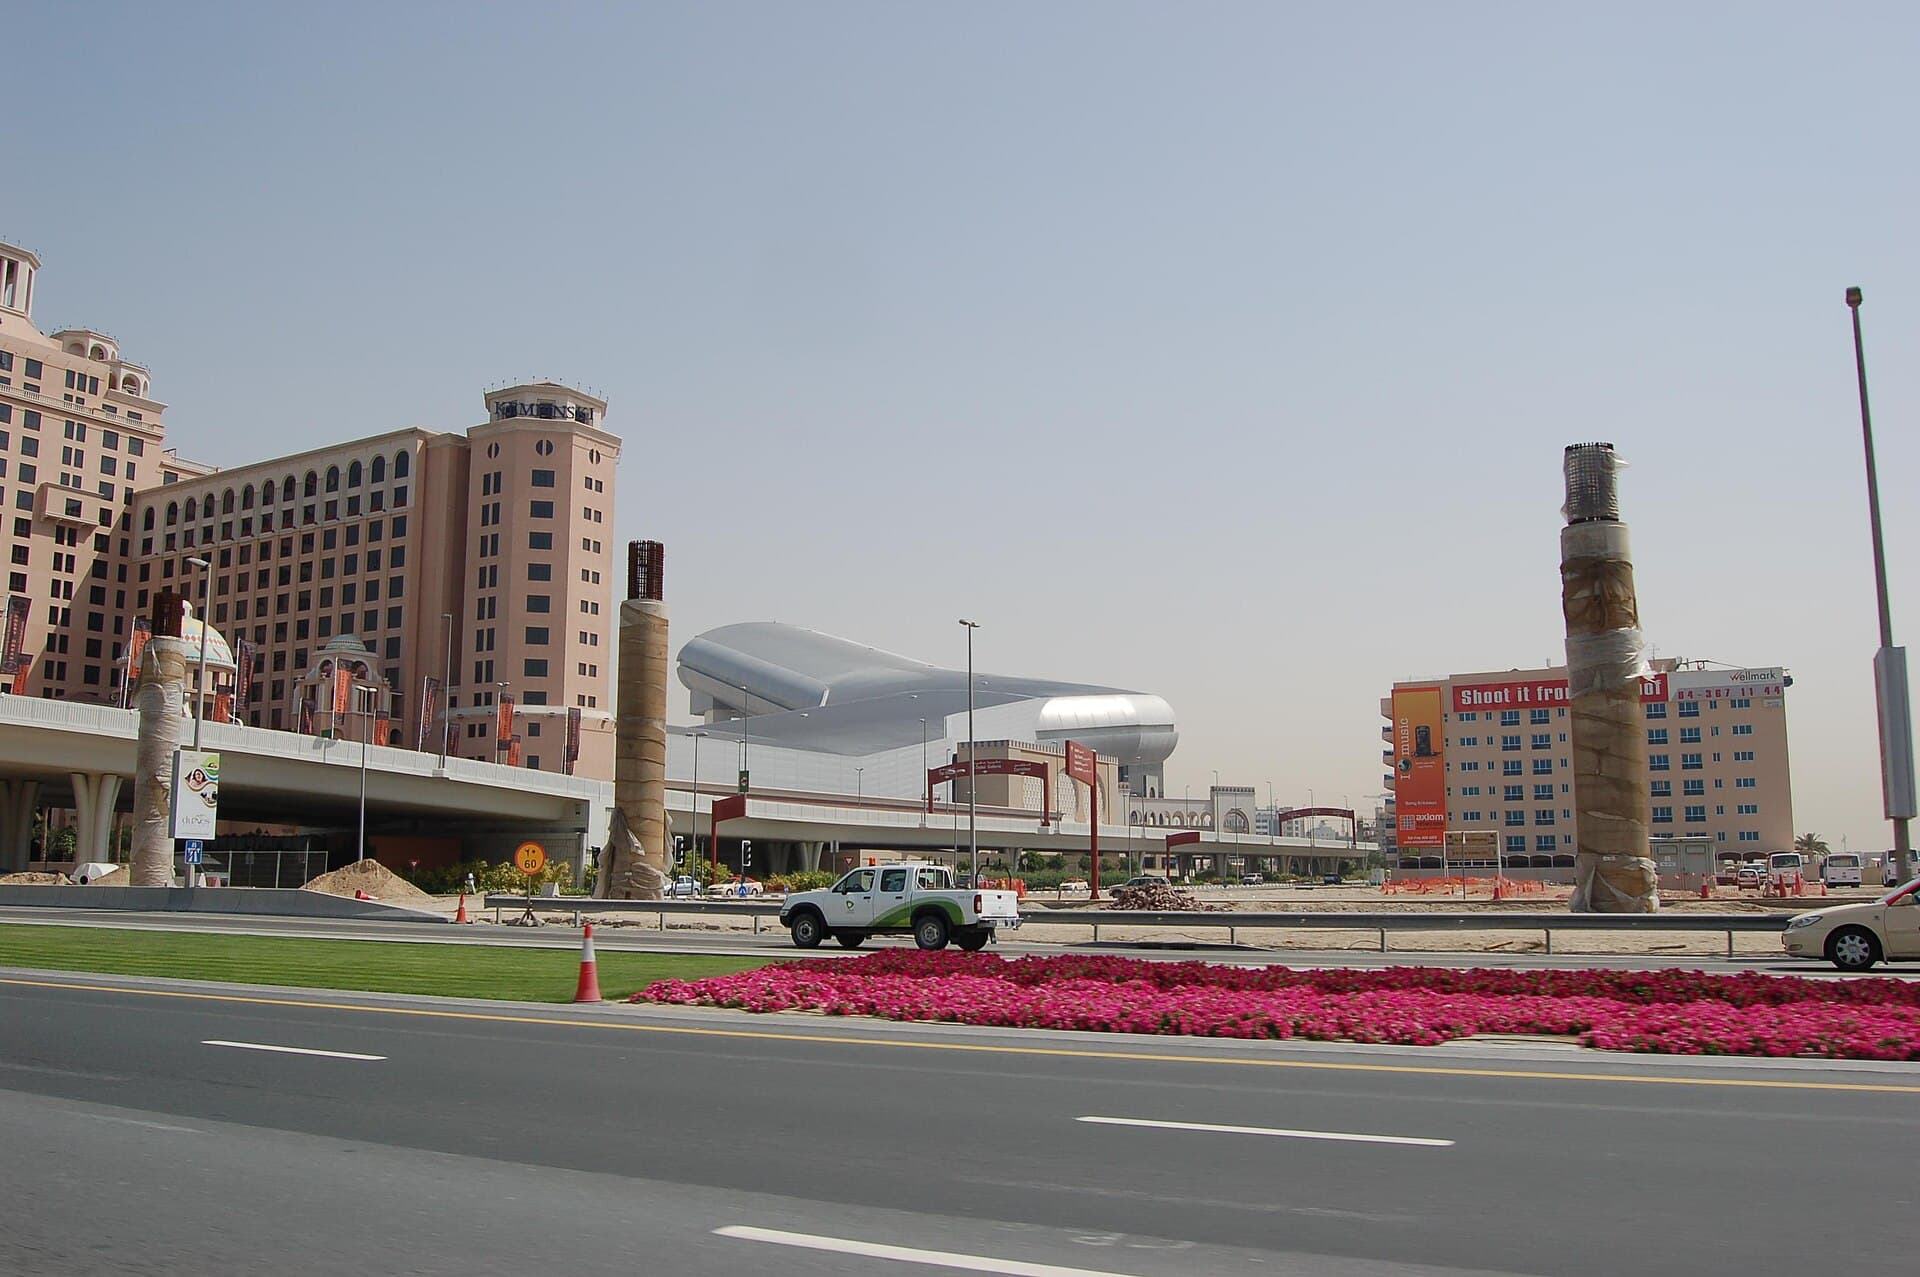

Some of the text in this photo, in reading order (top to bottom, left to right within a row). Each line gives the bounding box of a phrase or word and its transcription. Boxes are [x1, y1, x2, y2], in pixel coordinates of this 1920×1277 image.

[1730, 670, 1777, 681] Wellmark
[1461, 689, 1511, 705] Shoot
[1517, 686, 1530, 702] it
[1640, 680, 1662, 696] of
[1399, 718, 1409, 755] music
[1415, 813, 1444, 821] axiom
[524, 859, 537, 869] 60
